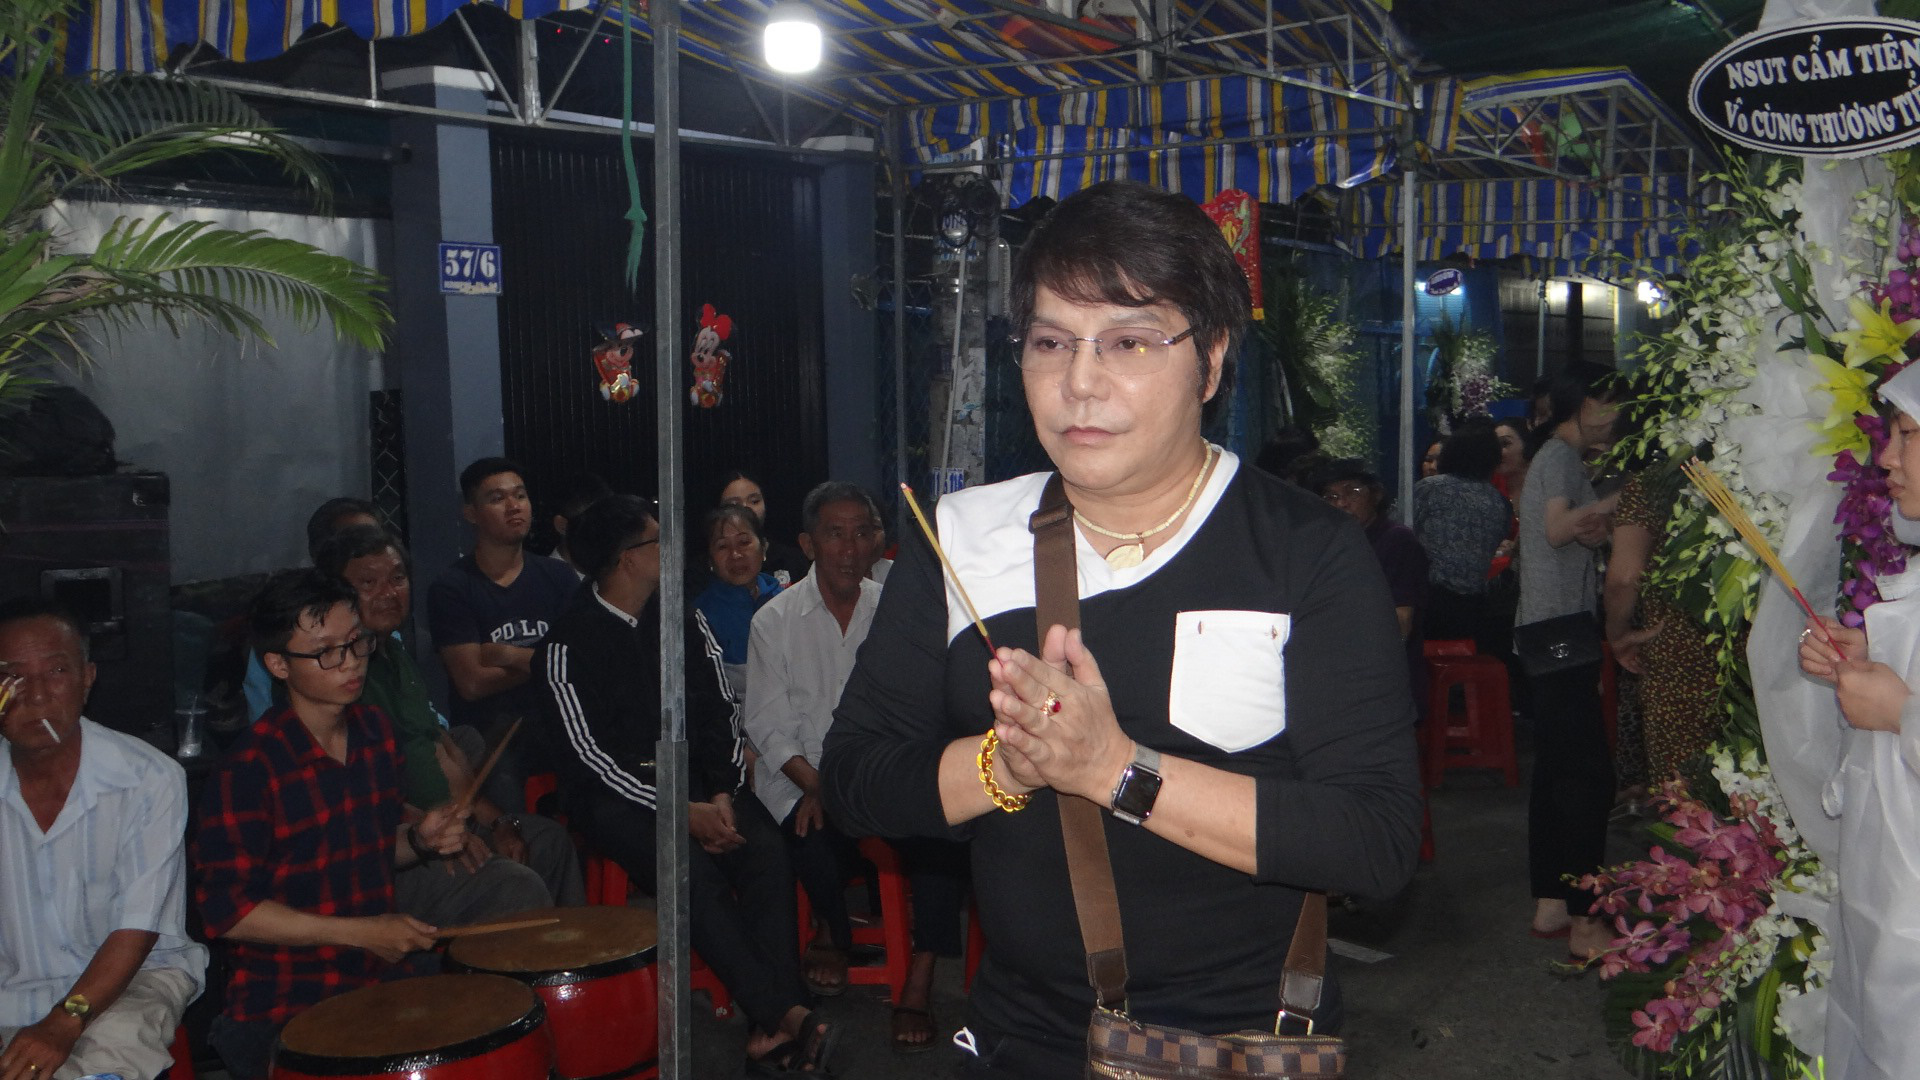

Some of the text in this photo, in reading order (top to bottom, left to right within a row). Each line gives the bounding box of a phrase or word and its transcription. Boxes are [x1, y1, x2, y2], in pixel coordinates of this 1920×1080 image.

[1725, 57, 1788, 90] NSUT
[1751, 103, 1806, 143] CÙNG
[1805, 102, 1896, 144] THƯƠNG
[445, 248, 496, 279] 57/6
[490, 619, 549, 643] POLO
